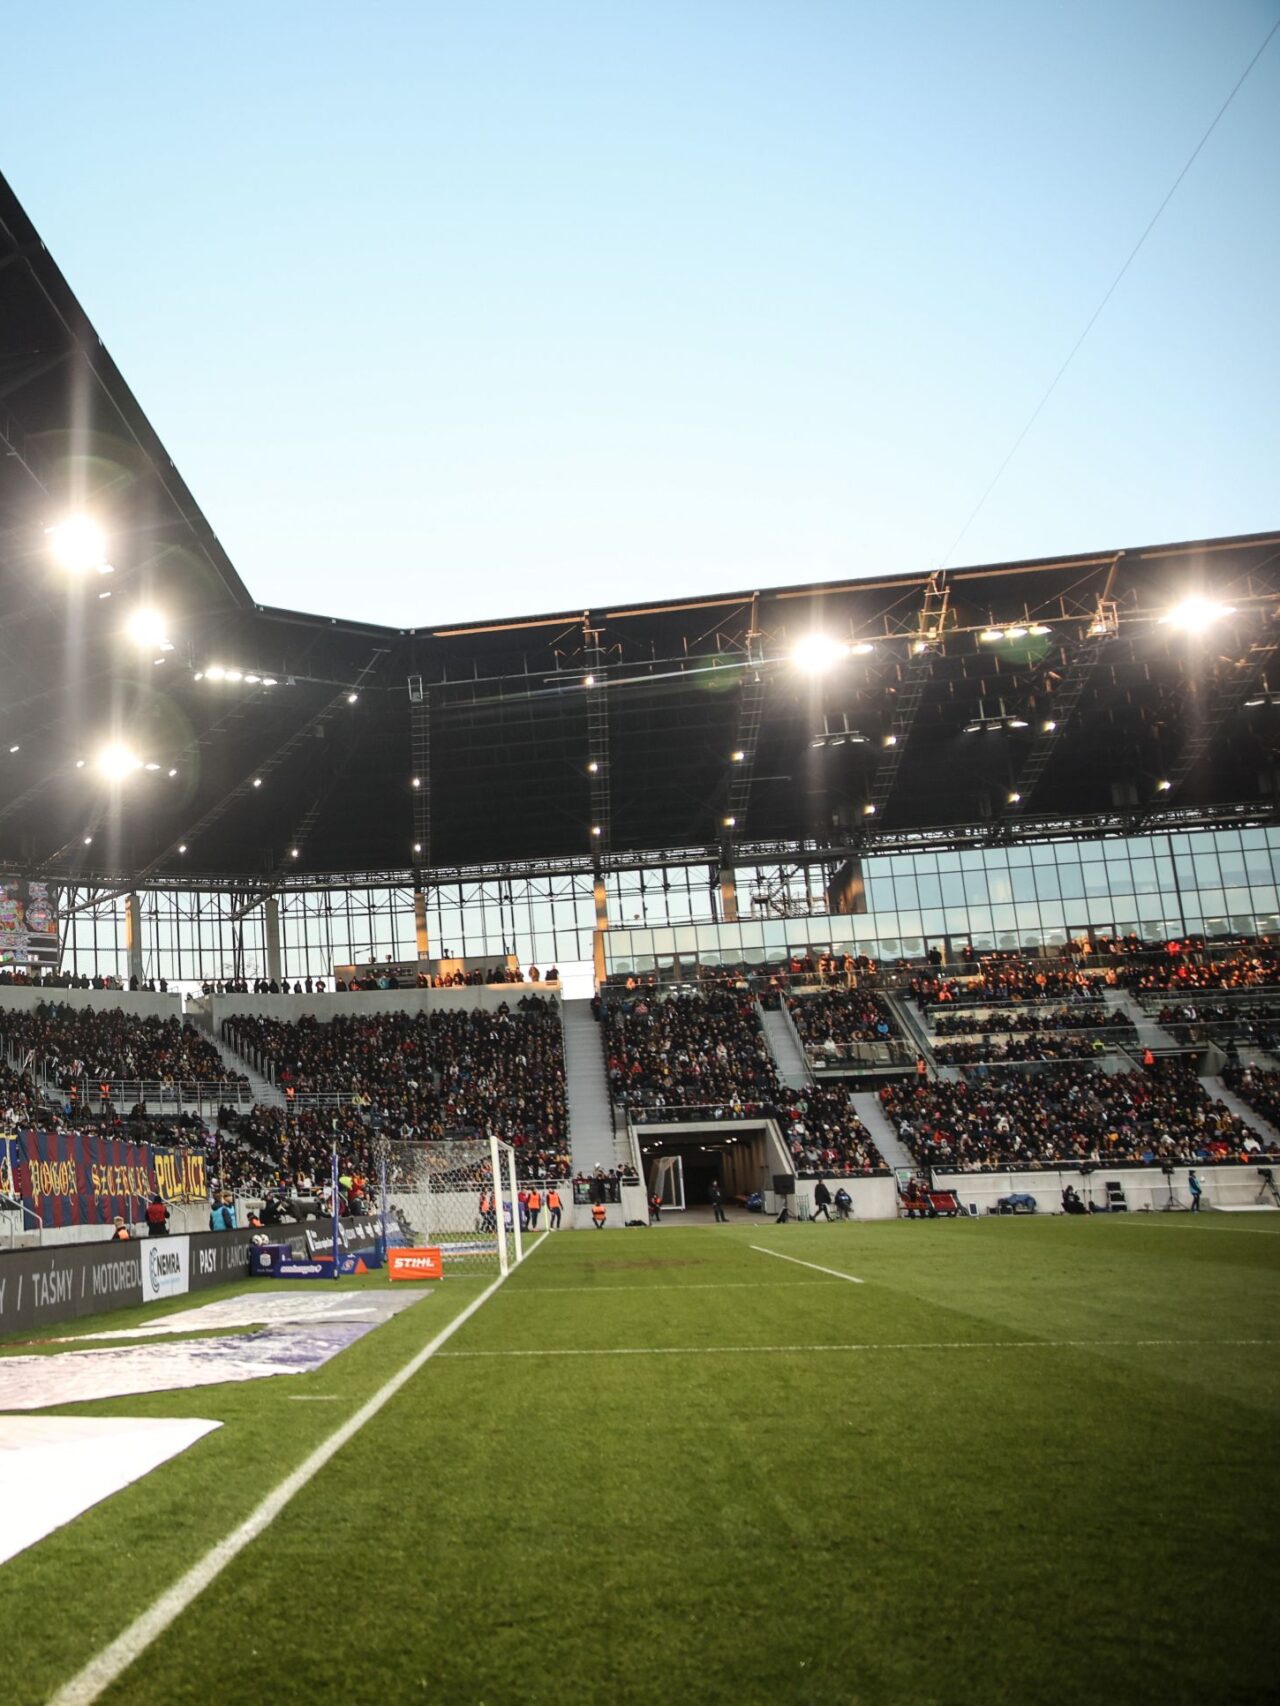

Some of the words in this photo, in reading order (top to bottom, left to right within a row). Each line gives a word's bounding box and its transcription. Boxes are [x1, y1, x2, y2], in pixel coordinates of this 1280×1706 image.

[157, 1251, 181, 1277] NEMRA
[199, 1248, 217, 1274] PASY
[394, 1257, 435, 1269] STIHL
[32, 1259, 73, 1307] TAŚMY
[92, 1259, 142, 1295] MOTOREDU
